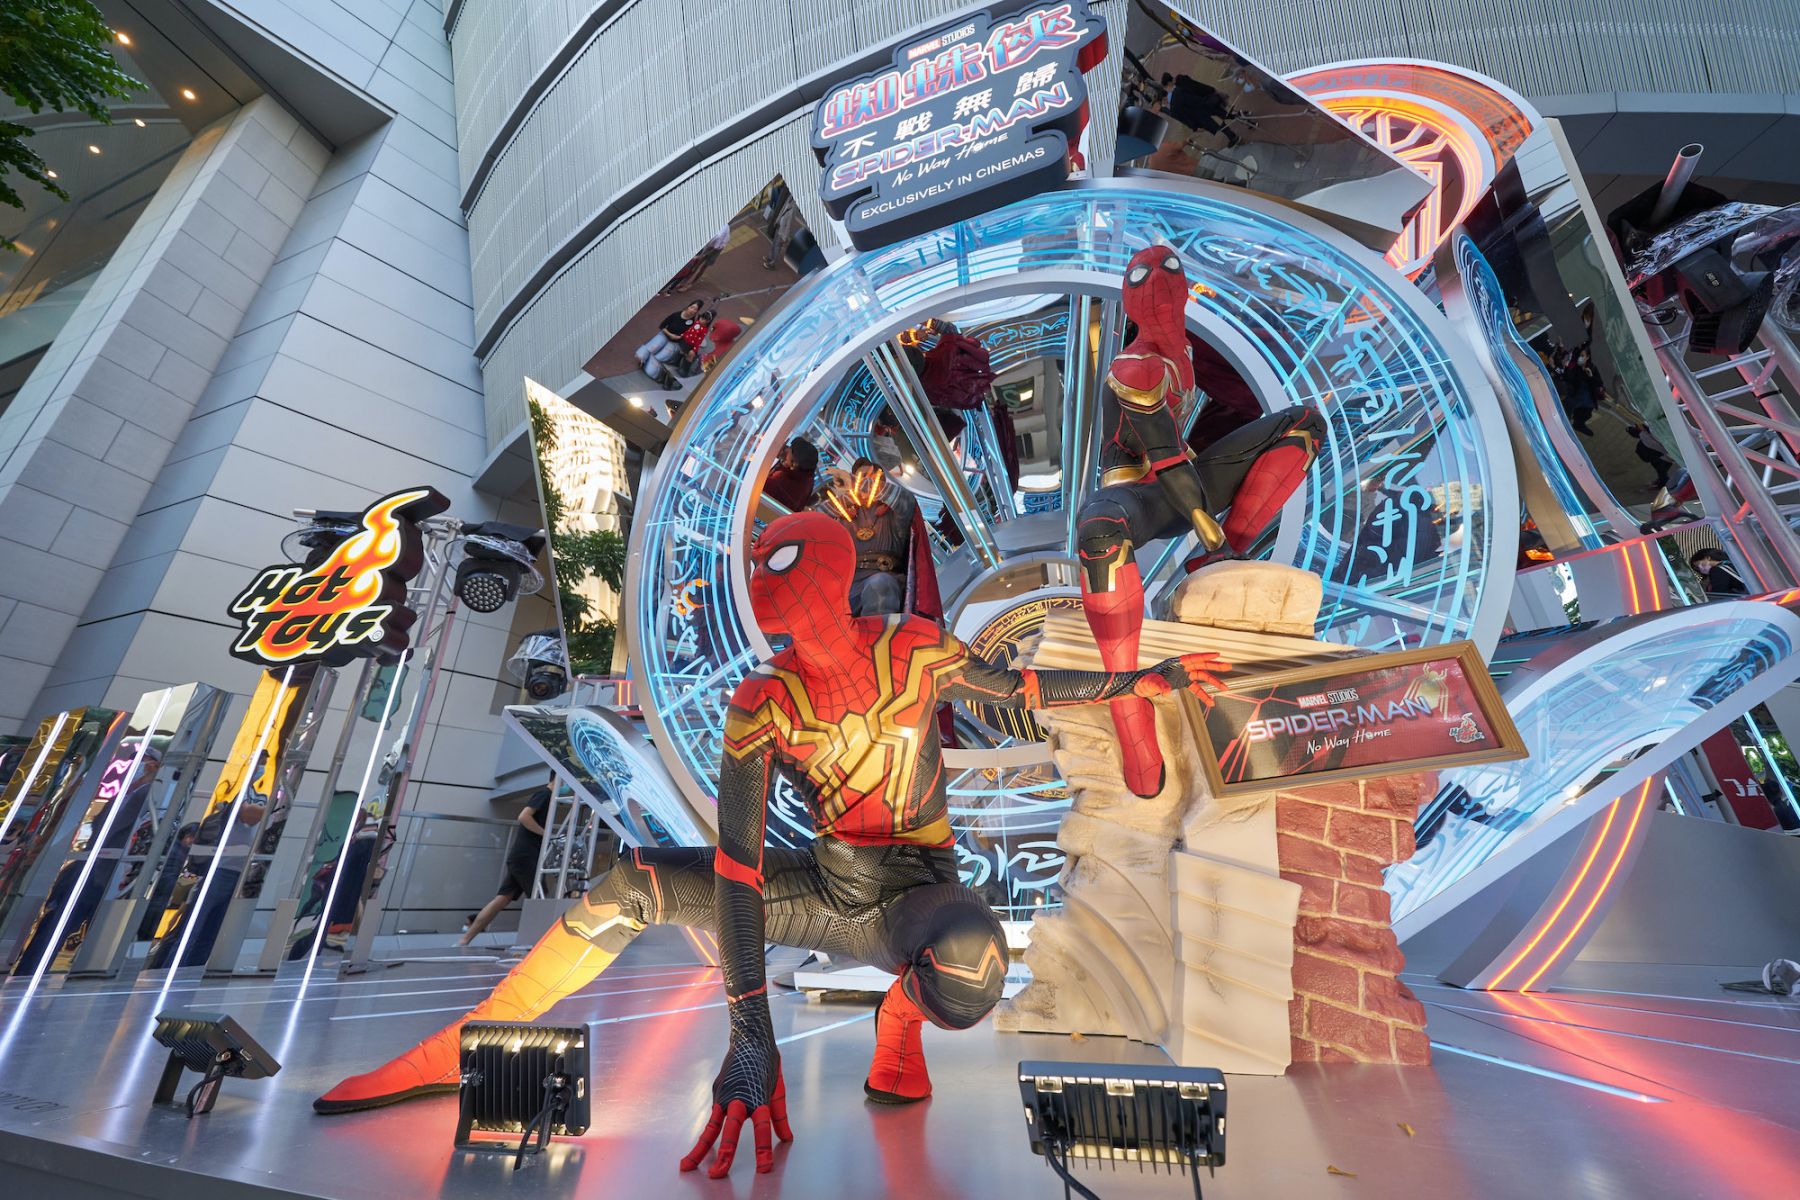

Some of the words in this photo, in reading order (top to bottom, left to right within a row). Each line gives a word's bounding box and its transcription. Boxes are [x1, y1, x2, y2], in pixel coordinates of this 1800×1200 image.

[908, 38, 941, 60] MARVEL
[941, 24, 975, 47] STUDIOS
[832, 81, 1072, 190] SPIDER-MAN
[861, 179, 955, 220] EXCLUSIVELY
[957, 173, 973, 186] IN
[976, 147, 1046, 180] CINEMAS
[892, 169, 914, 188] No
[917, 156, 951, 178] Way
[1298, 693, 1329, 708] MARVEL
[1328, 688, 1360, 705] STUDIOS
[1246, 695, 1434, 742] SPIDER-MAN
[1307, 739, 1322, 755] No
[1324, 735, 1350, 751] Way
